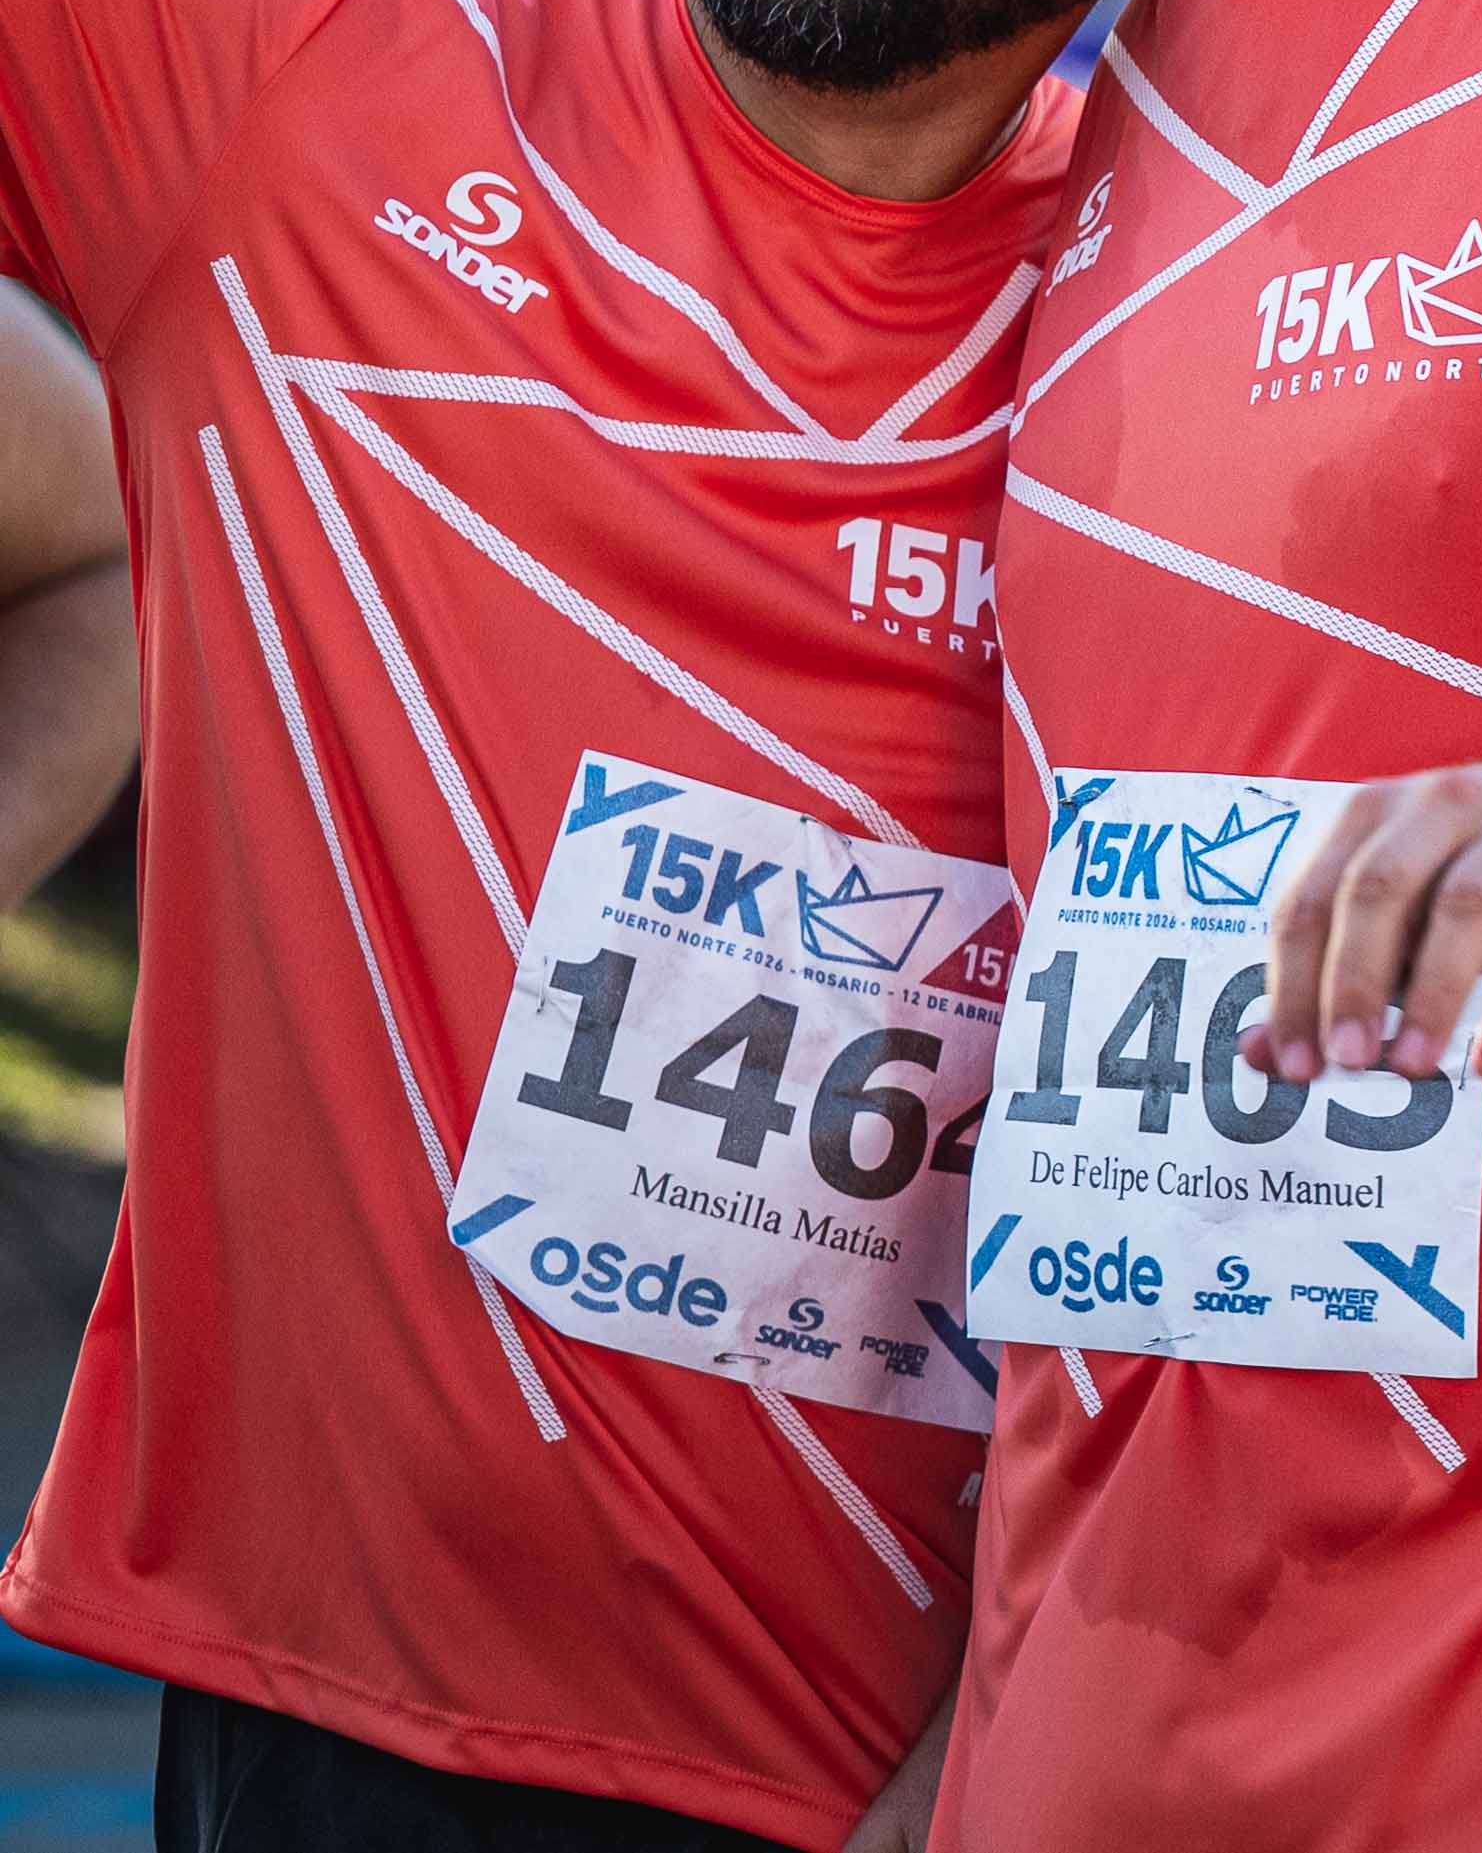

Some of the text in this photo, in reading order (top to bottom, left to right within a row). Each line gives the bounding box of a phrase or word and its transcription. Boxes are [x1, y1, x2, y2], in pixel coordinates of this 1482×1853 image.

[1256, 257, 1392, 370] 15K
[1250, 363, 1369, 405] PUERTO
[852, 609, 996, 660] PUERT
[622, 824, 782, 938] 15K
[1072, 820, 1174, 900] 15K
[1058, 909, 1099, 924] PUERTO
[1104, 912, 1141, 928] NORTE
[1146, 914, 1176, 929] 2026
[1191, 916, 1246, 934] ROSARIO
[601, 907, 670, 938] PUERTO
[677, 928, 735, 957] NORTE
[743, 948, 783, 973] 2026
[803, 967, 881, 996] ROSARIO
[902, 989, 919, 1005] 12
[927, 994, 949, 1012] DE
[954, 1001, 1001, 1026] ABRIL
[630, 1164, 902, 1263] Mansilla Matías
[1030, 1150, 1385, 1208] De Felipe Carlos Manuel
[530, 1236, 728, 1327] osde
[1029, 1235, 1163, 1310] osde
[1290, 1285, 1378, 1305] POWER
[860, 1335, 930, 1362] POWER
